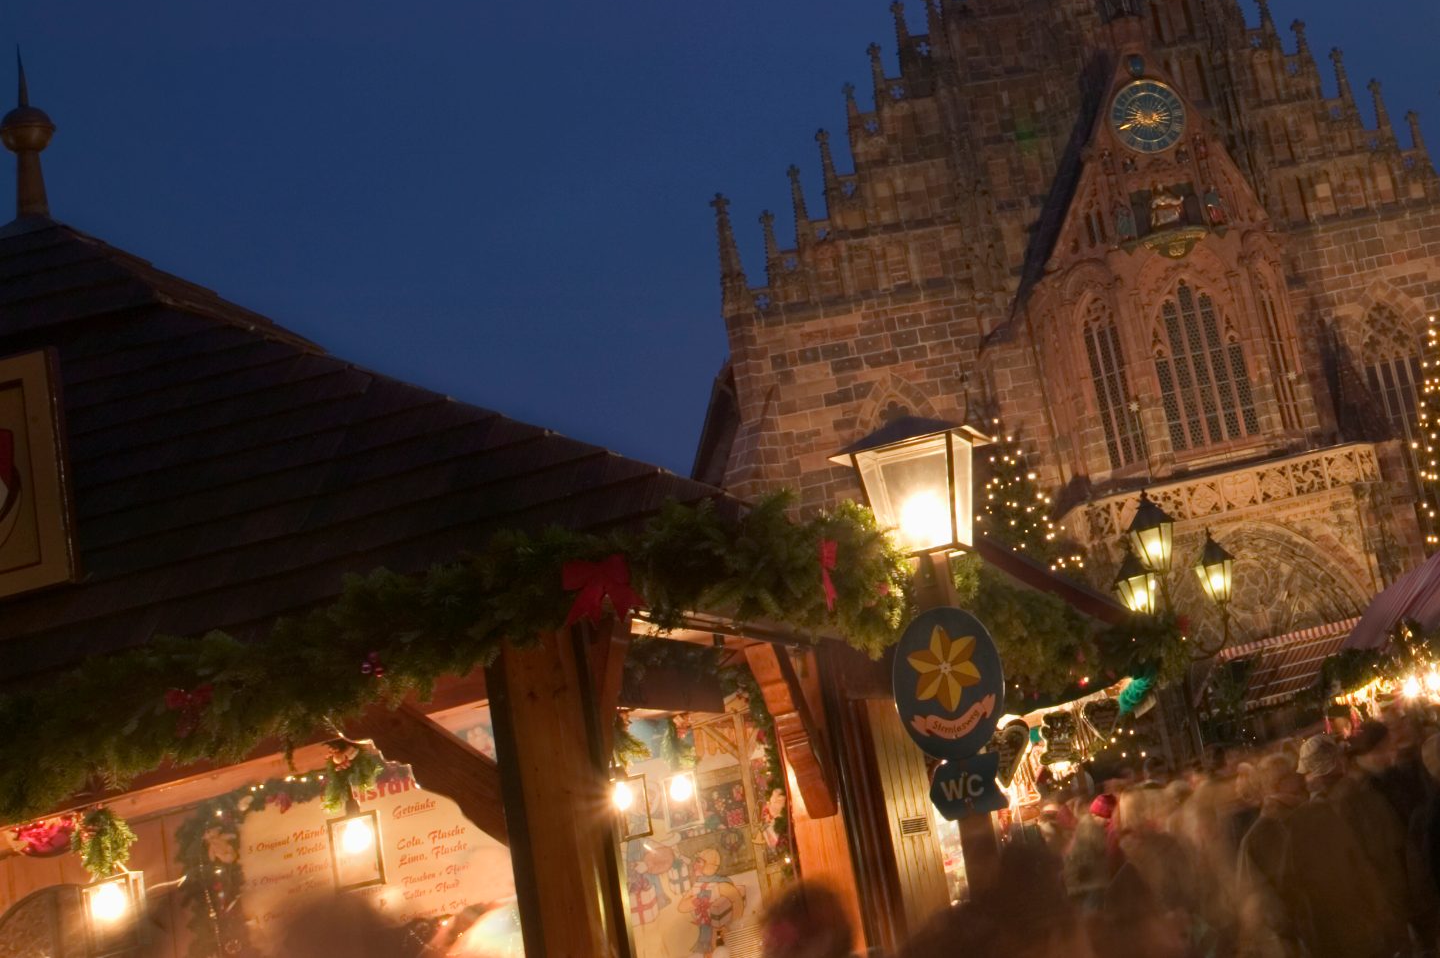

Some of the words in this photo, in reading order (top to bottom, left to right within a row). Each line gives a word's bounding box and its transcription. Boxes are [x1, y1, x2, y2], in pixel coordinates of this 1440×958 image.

[940, 773, 985, 802] WC
[392, 798, 437, 820] Getränke
[256, 836, 290, 852] Original
[427, 825, 466, 844] Flasche
[431, 840, 468, 859] Flasche
